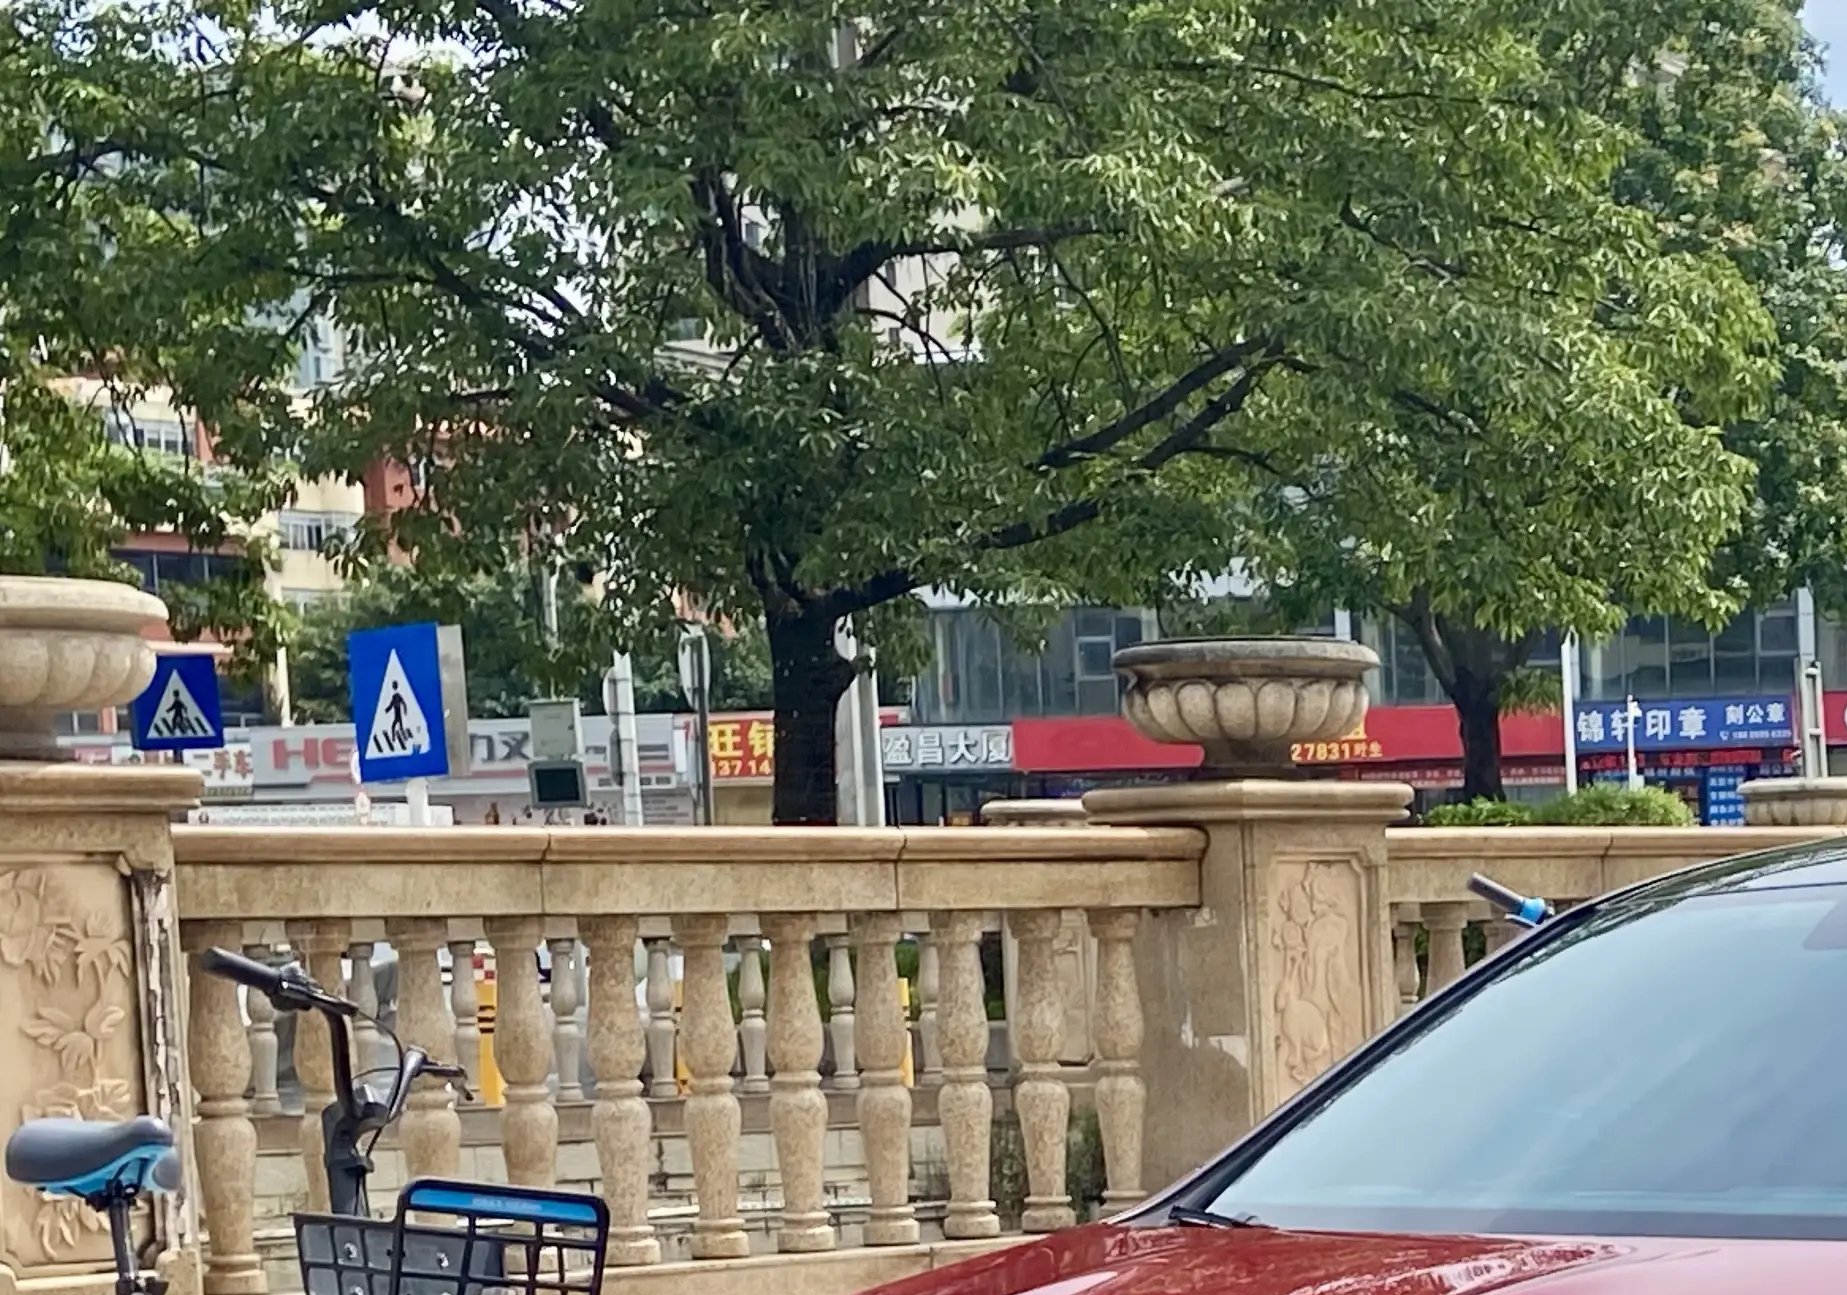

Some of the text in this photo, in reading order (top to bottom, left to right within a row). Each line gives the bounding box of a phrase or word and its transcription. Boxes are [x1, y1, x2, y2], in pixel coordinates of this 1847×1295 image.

[1577, 707, 1707, 743] 锦轩印章
[1725, 702, 1786, 725] 刻公章
[882, 729, 1012, 765] 盈昌大厦
